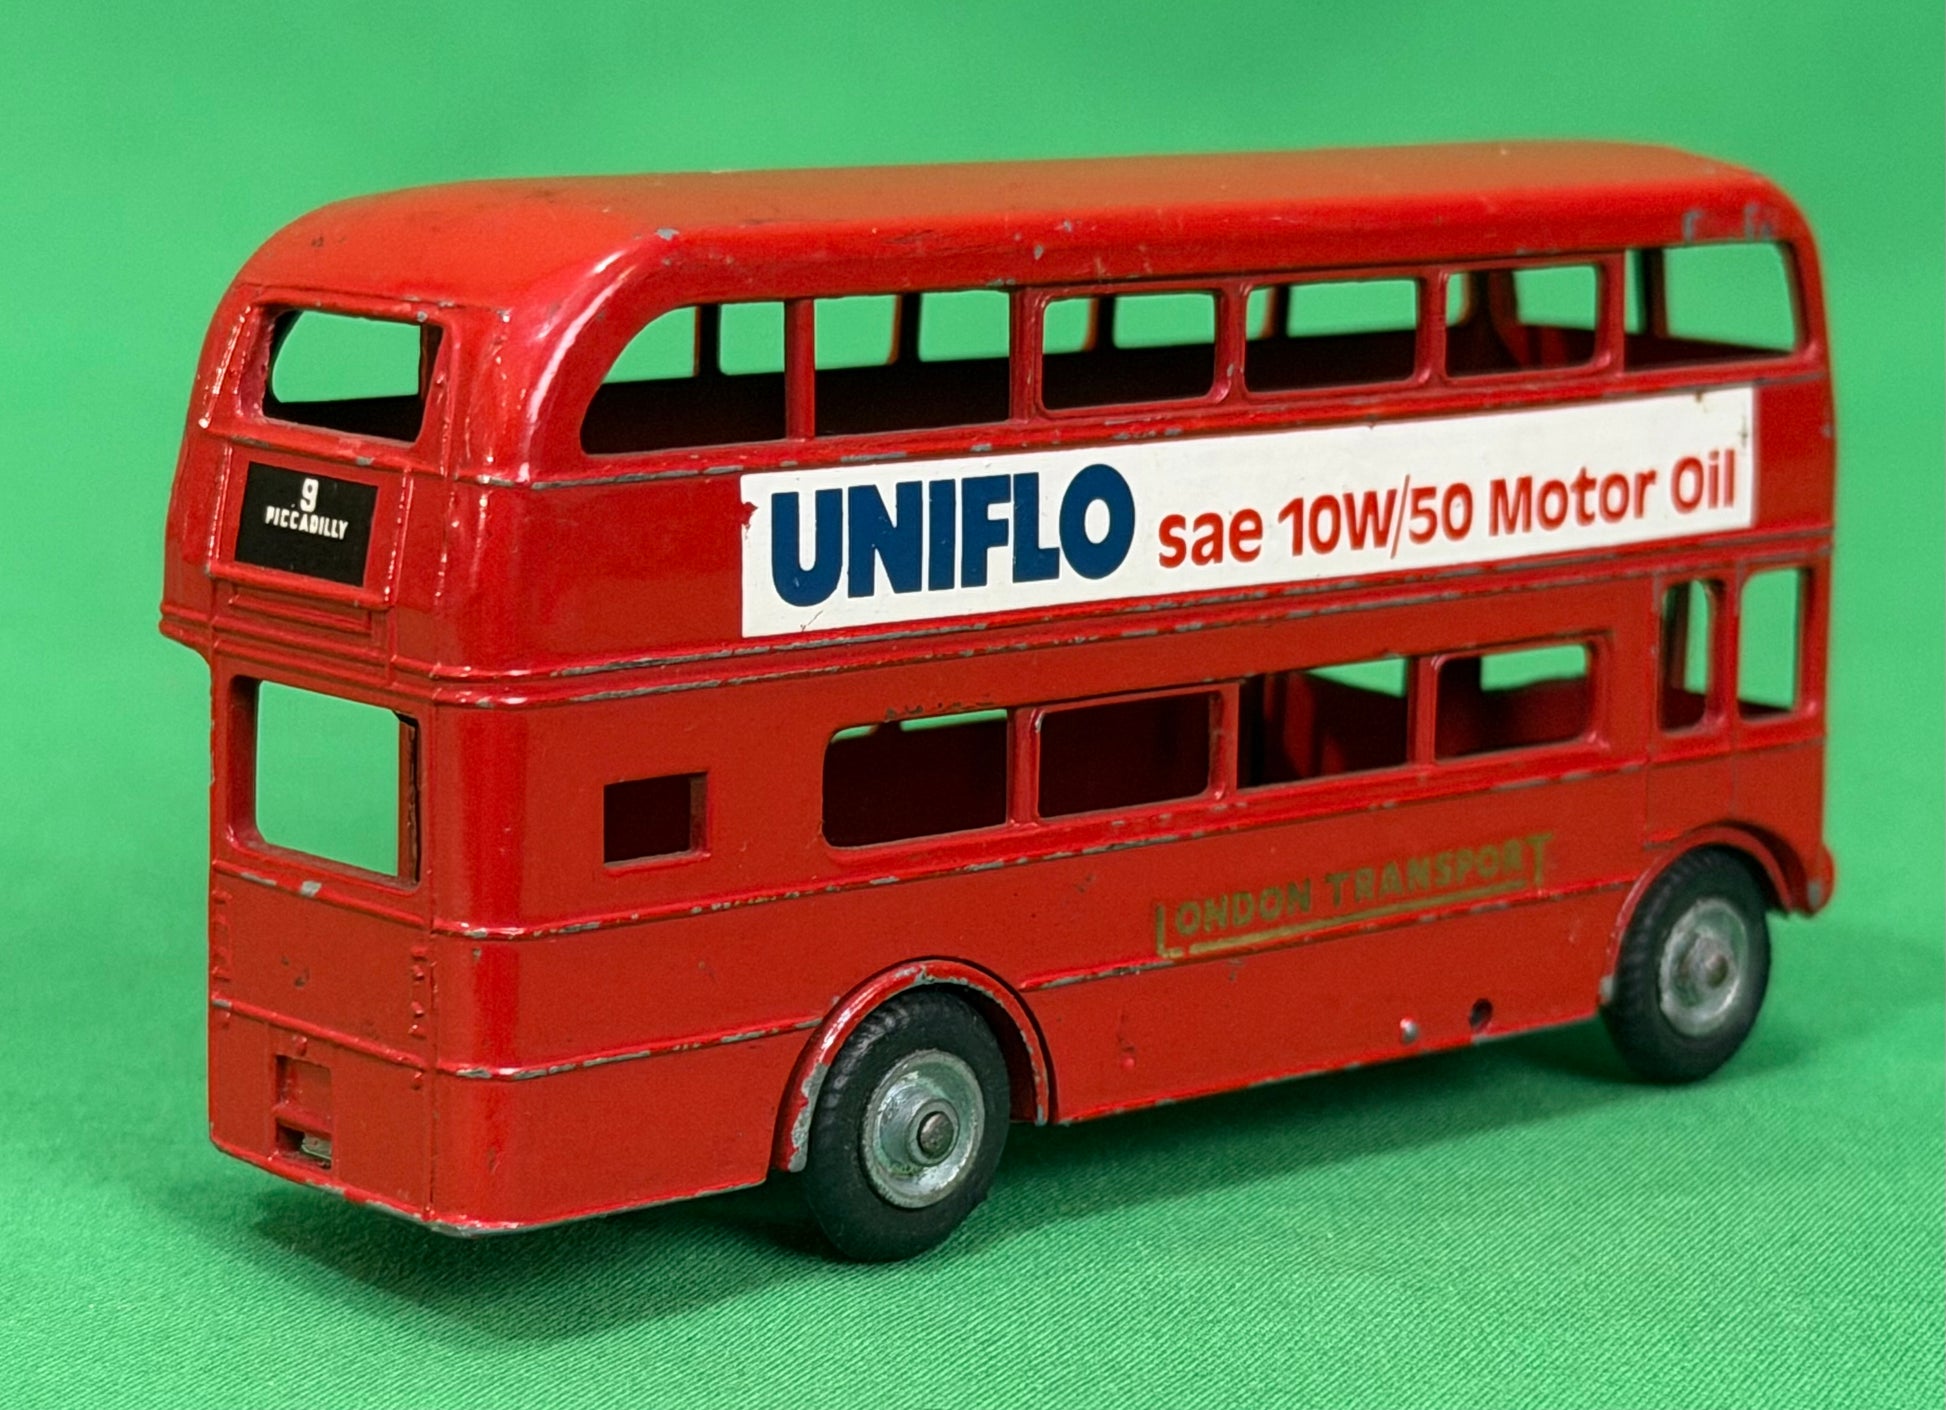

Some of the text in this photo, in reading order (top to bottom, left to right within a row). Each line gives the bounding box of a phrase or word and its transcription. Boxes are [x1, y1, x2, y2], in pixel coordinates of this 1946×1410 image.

[264, 505, 349, 540] PICCADILLY
[300, 478, 319, 512] 9
[771, 447, 1737, 607] UNIFLO sae 10W/50 Motor Oil
[1155, 832, 1555, 959] LONDON TRANSPORT
